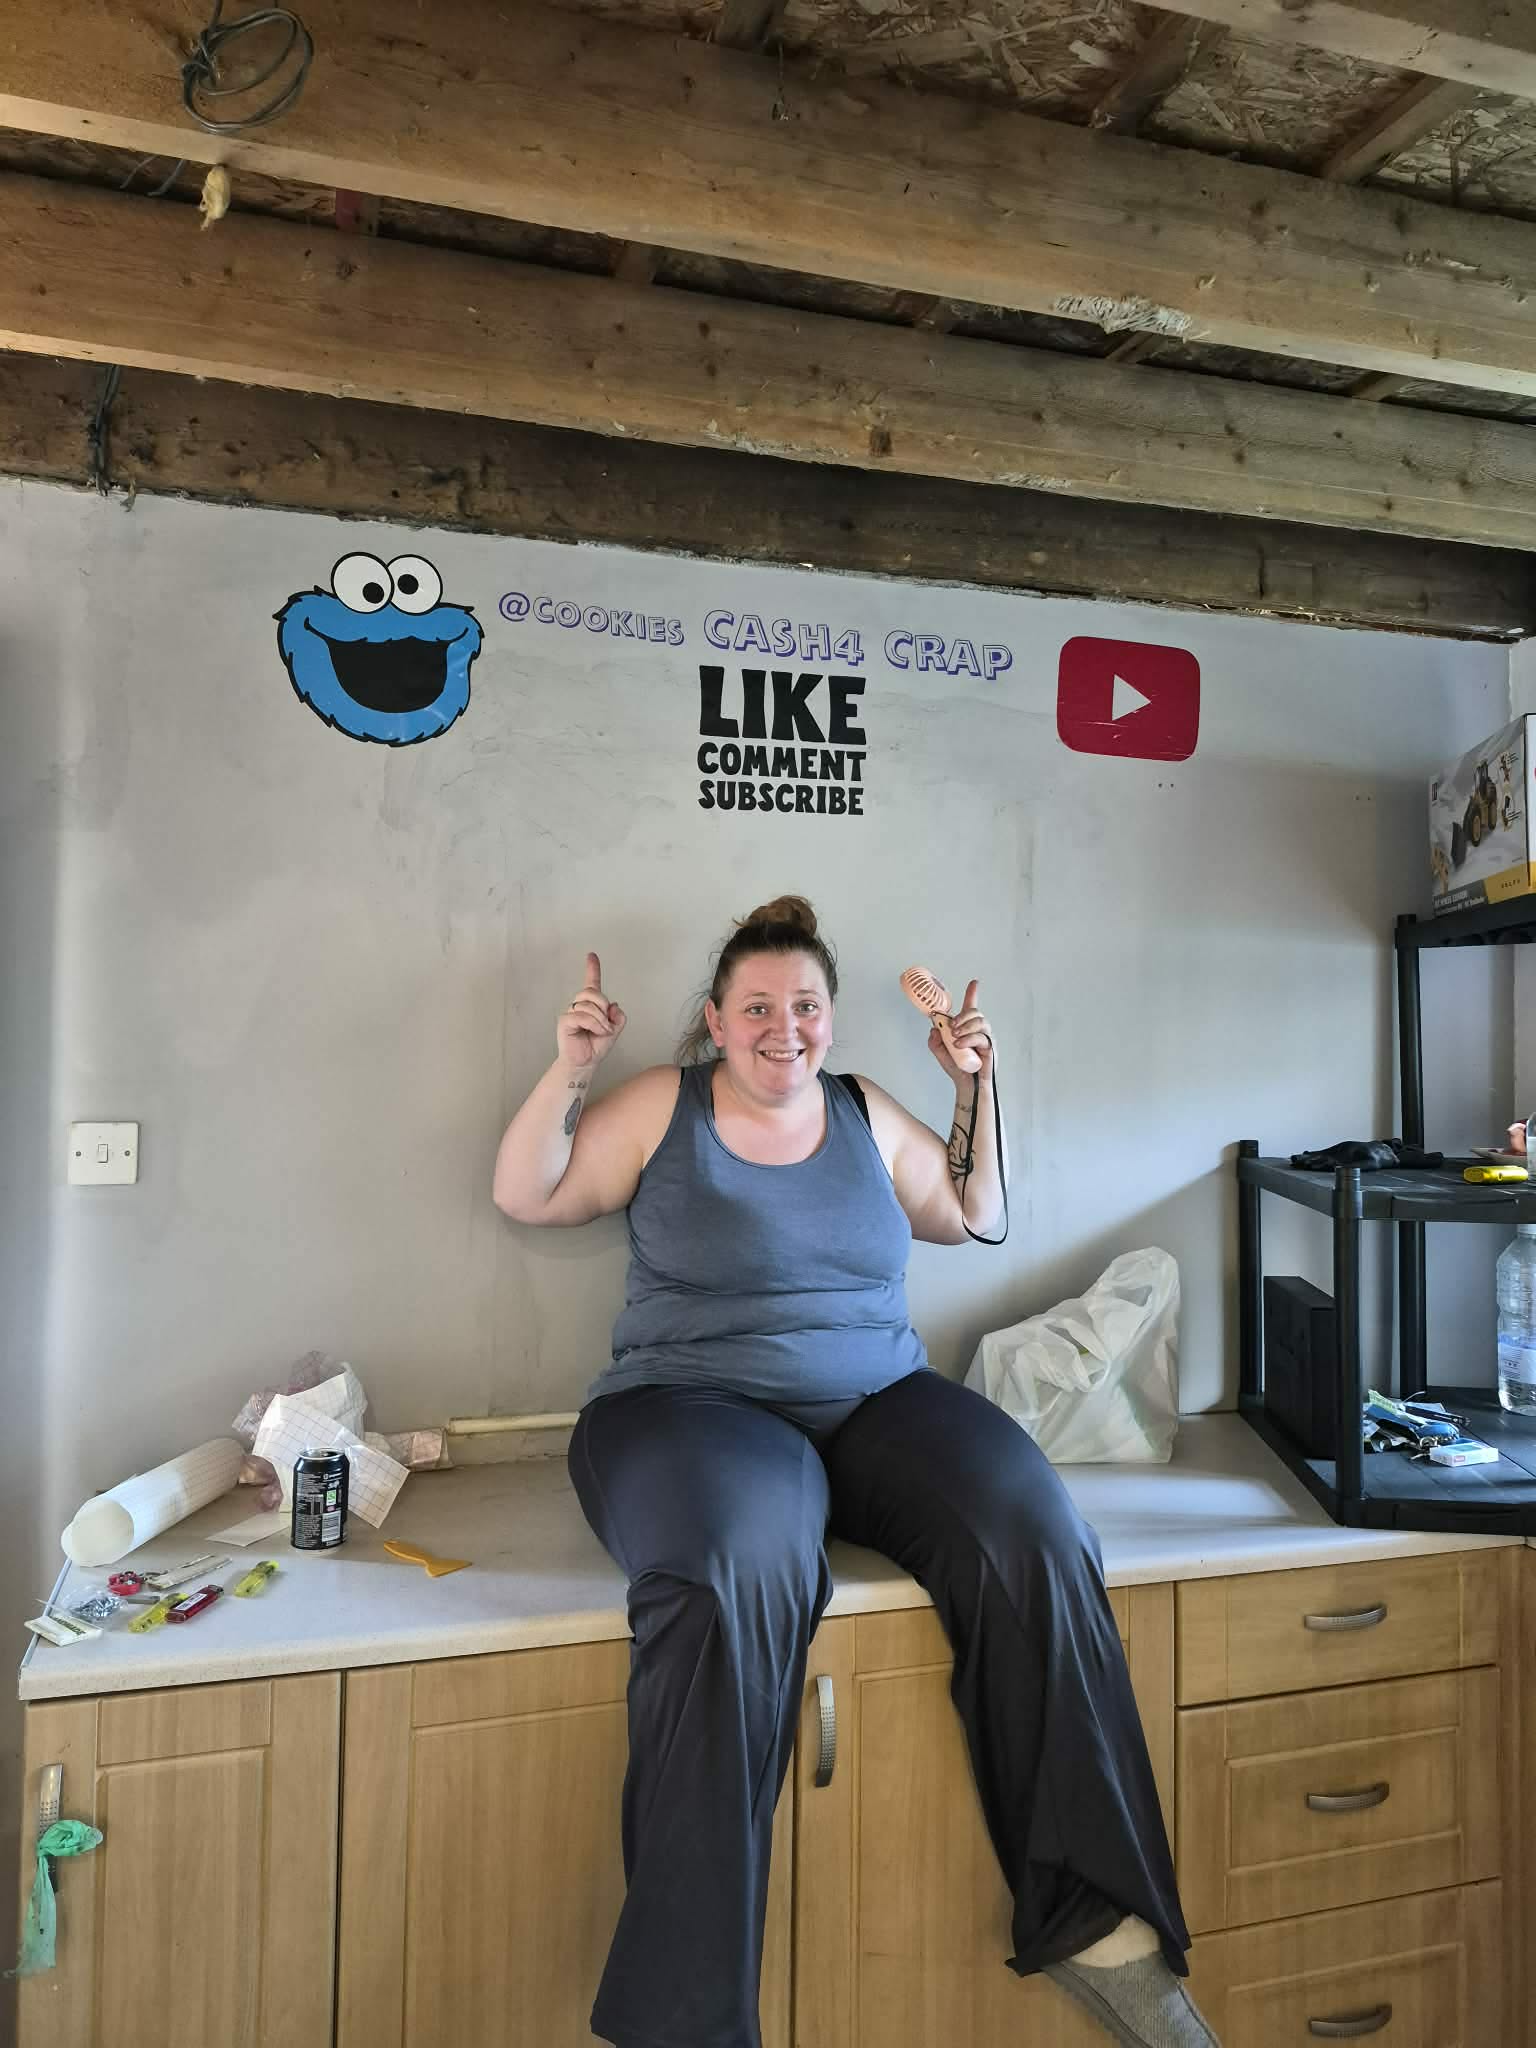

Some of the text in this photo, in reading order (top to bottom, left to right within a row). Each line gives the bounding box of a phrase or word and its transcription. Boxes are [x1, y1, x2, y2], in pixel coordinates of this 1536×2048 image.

[498, 592, 1013, 680] @COOKIES CASH4 CRAP
[699, 665, 866, 745] LIKE
[697, 742, 866, 781] COMMENT
[698, 780, 864, 815] SUBSCRIBE
